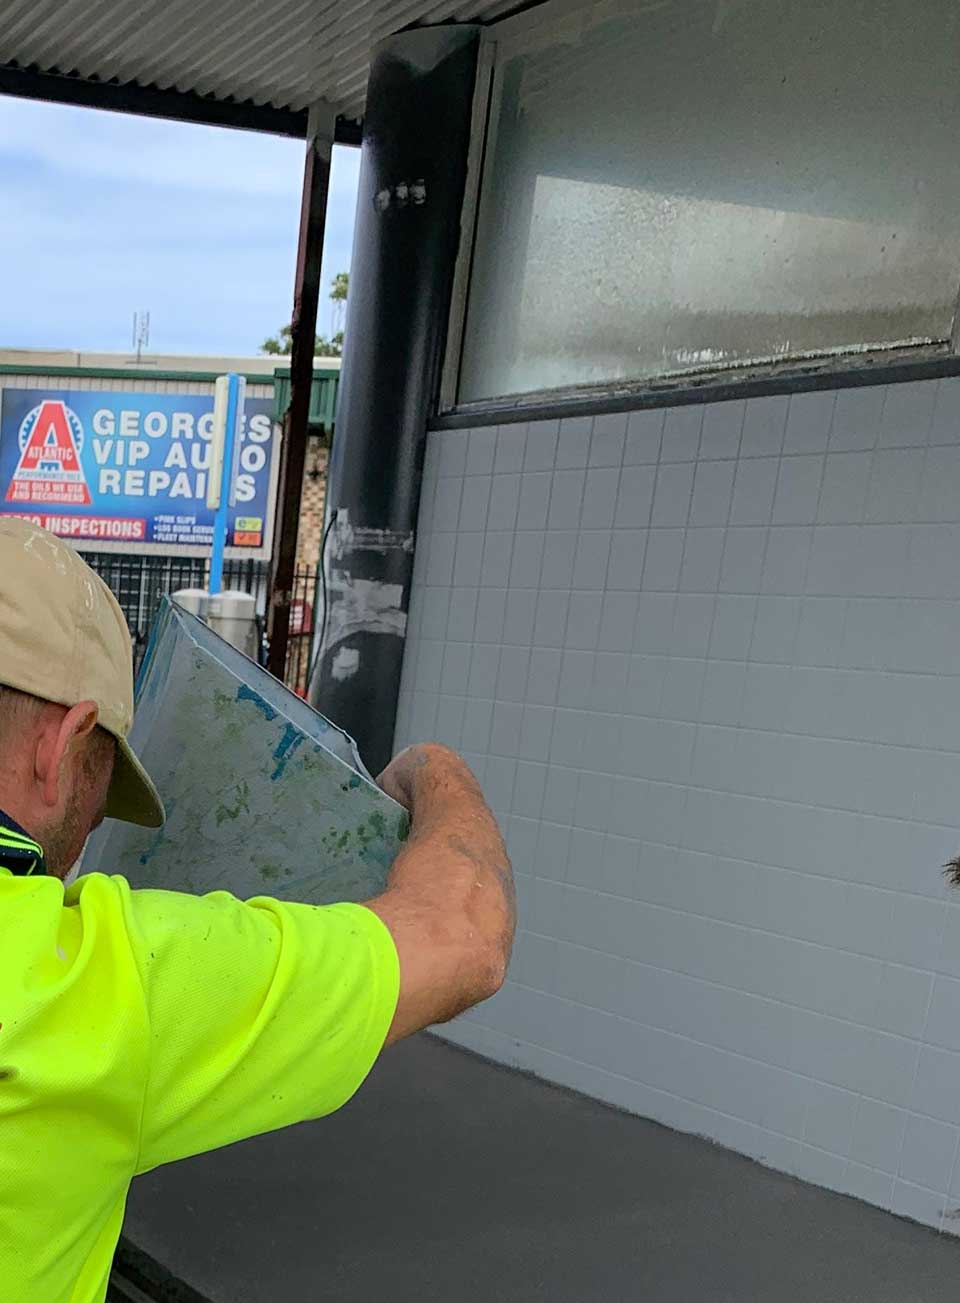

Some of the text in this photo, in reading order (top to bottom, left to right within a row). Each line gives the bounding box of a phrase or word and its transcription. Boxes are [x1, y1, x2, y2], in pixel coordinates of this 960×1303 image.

[27, 446, 74, 461] ATLANTIC
[92, 439, 267, 473] VIP AUO
[14, 481, 84, 493] THE OILS WE USE
[98, 469, 257, 502] REPAIS
[12, 490, 85, 502] AND RECOMMEND
[45, 517, 142, 537] INSPECTIONS
